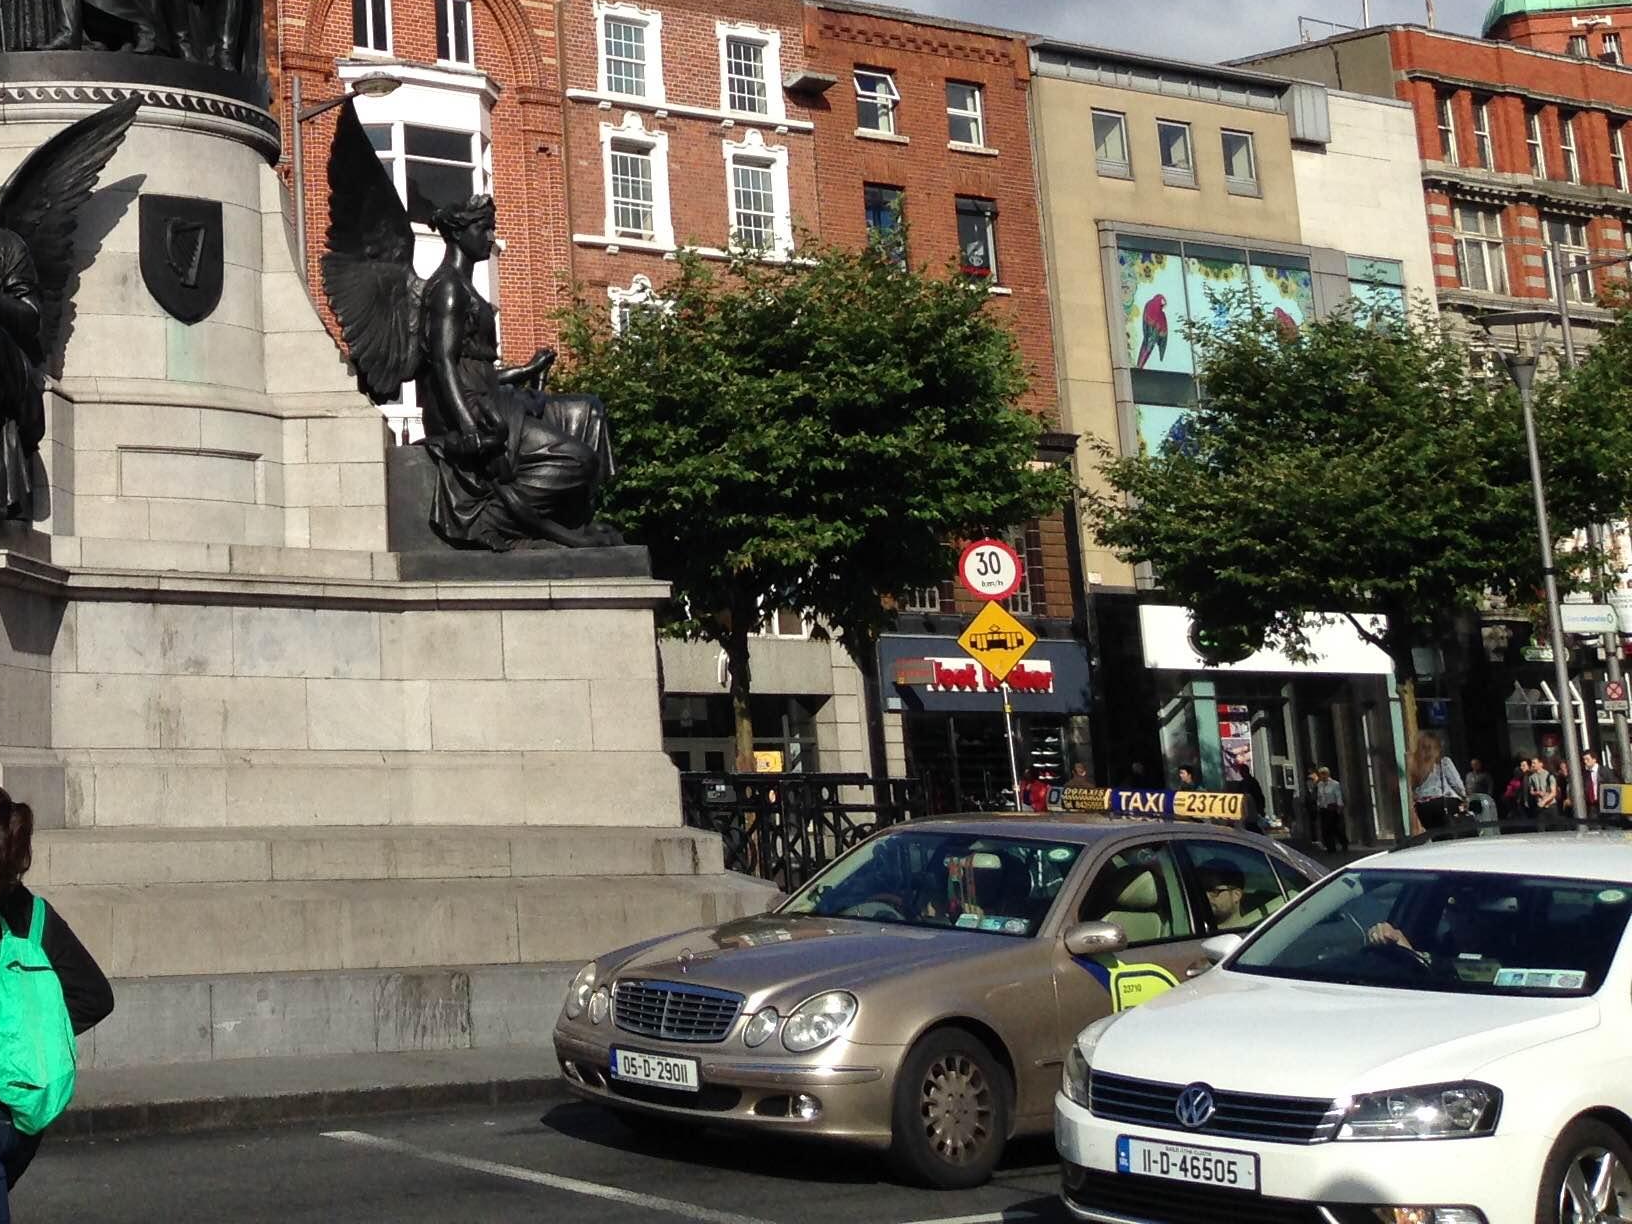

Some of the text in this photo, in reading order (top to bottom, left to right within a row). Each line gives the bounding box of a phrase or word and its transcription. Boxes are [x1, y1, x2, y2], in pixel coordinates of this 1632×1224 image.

[975, 551, 1001, 576] 30
[1118, 791, 1239, 815] TAXI 23710
[1603, 788, 1620, 810] D
[1123, 983, 1142, 993] 23710
[623, 1055, 688, 1083] 05-D-29011
[1143, 1149, 1238, 1184] 11-D-46505
